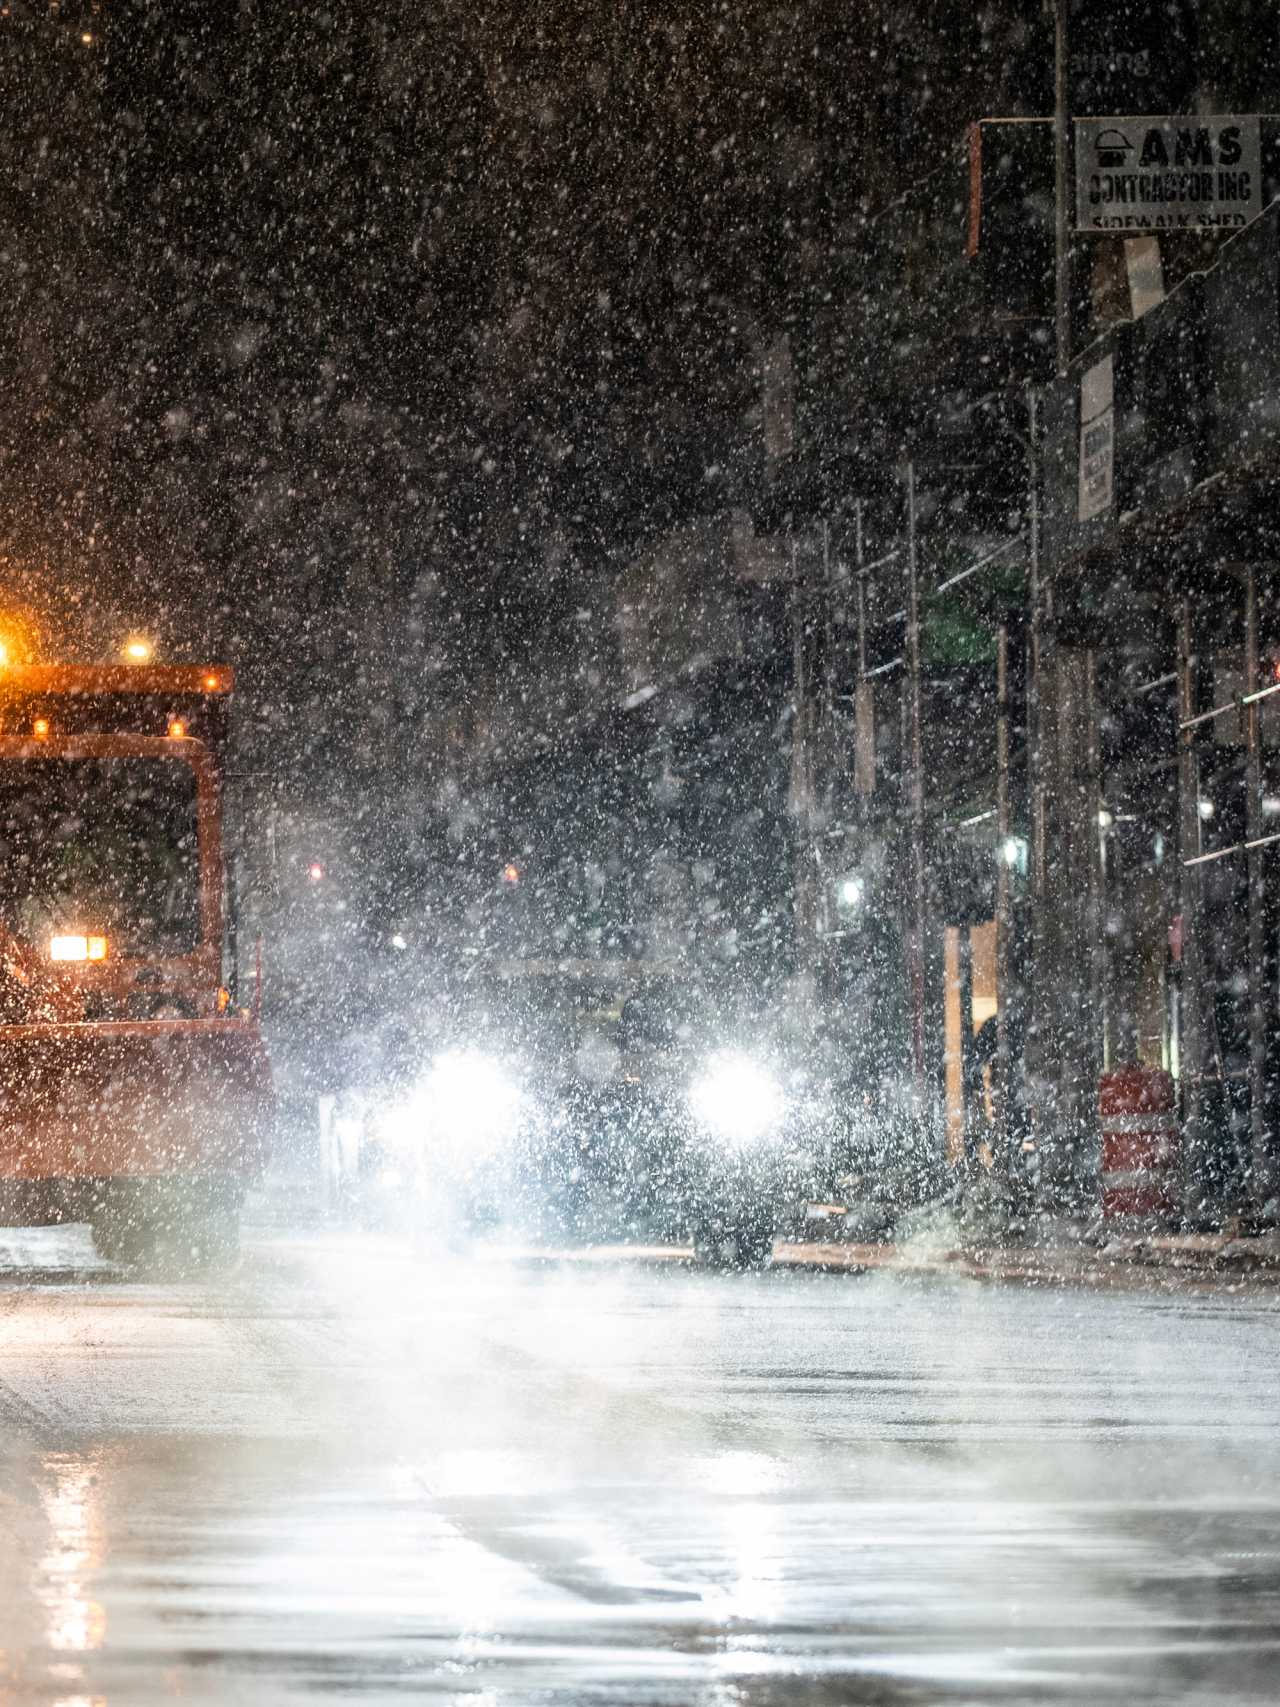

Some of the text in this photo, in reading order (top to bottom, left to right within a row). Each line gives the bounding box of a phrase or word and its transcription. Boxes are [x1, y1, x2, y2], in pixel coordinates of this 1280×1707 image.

[1139, 126, 1242, 167] AMS
[1090, 171, 1252, 204] CONTRACTOR INC
